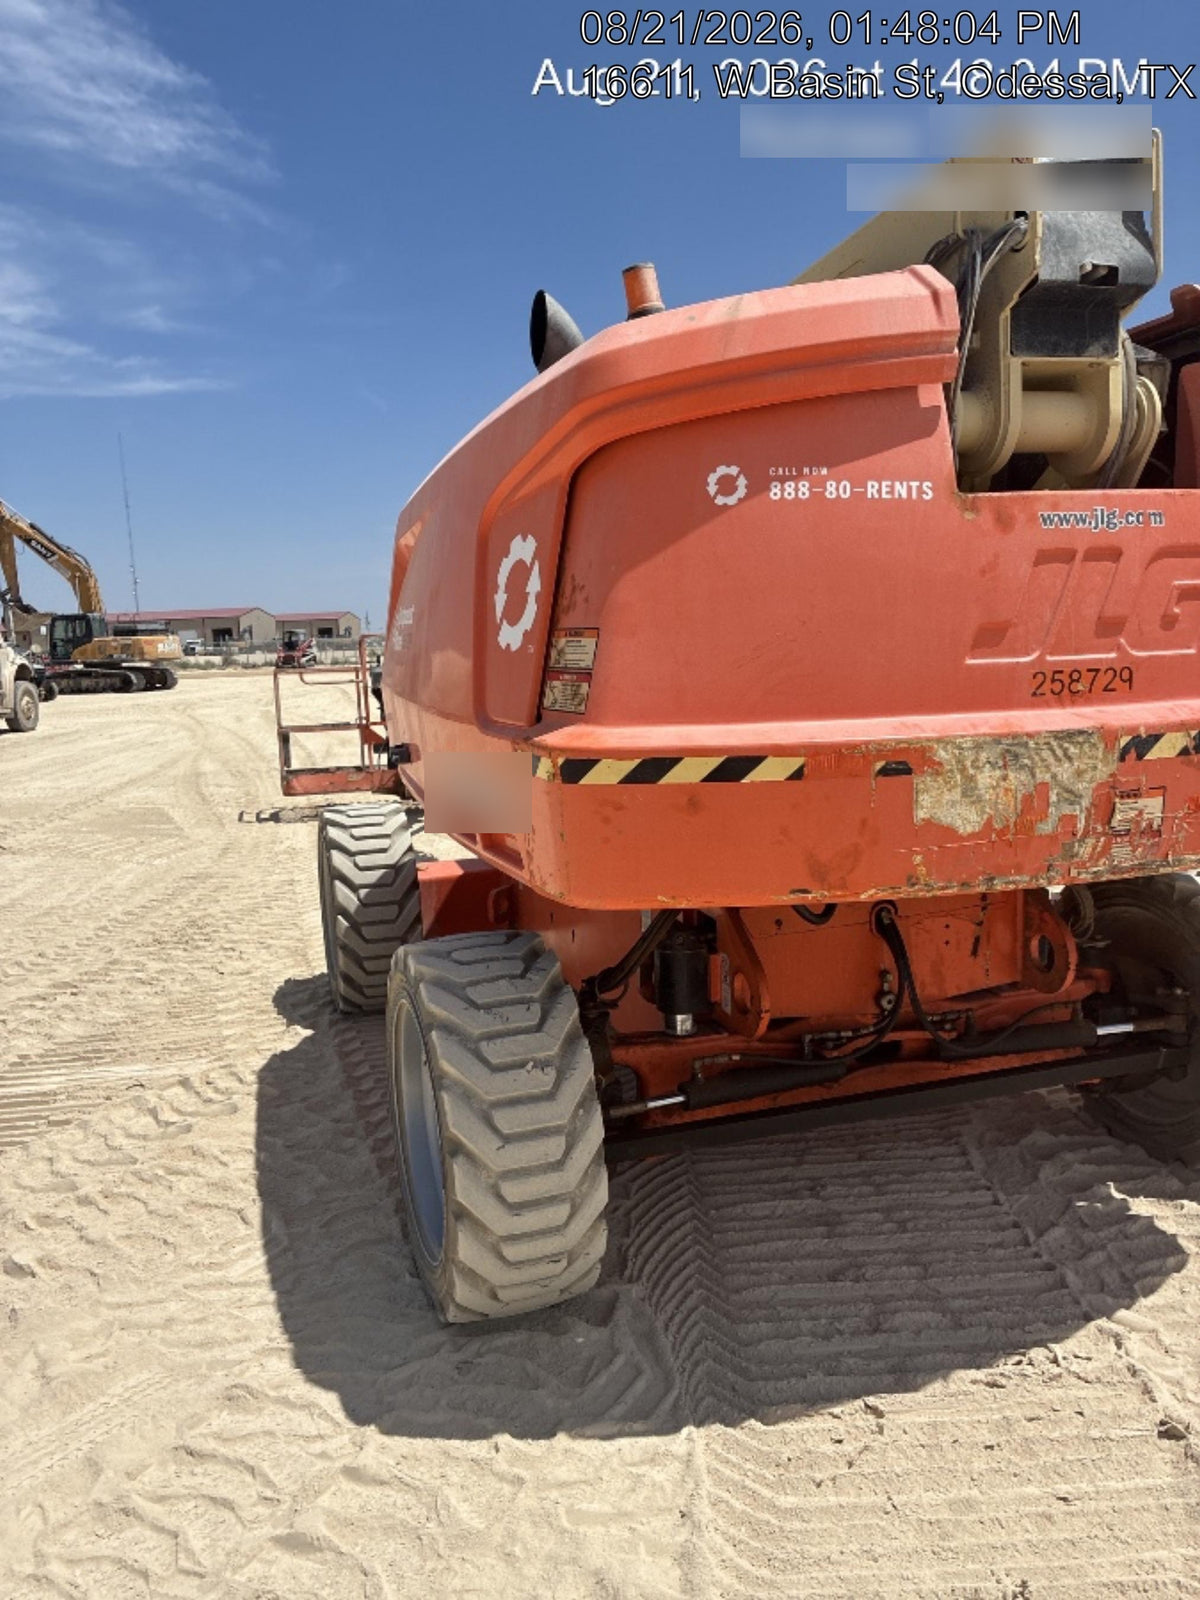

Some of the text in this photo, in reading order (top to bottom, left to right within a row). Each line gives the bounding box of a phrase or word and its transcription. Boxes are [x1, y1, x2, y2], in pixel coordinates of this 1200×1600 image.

[768, 466, 798, 476] CALL
[768, 480, 934, 500] 888-80-RENTS
[1030, 666, 1134, 697] 258729
